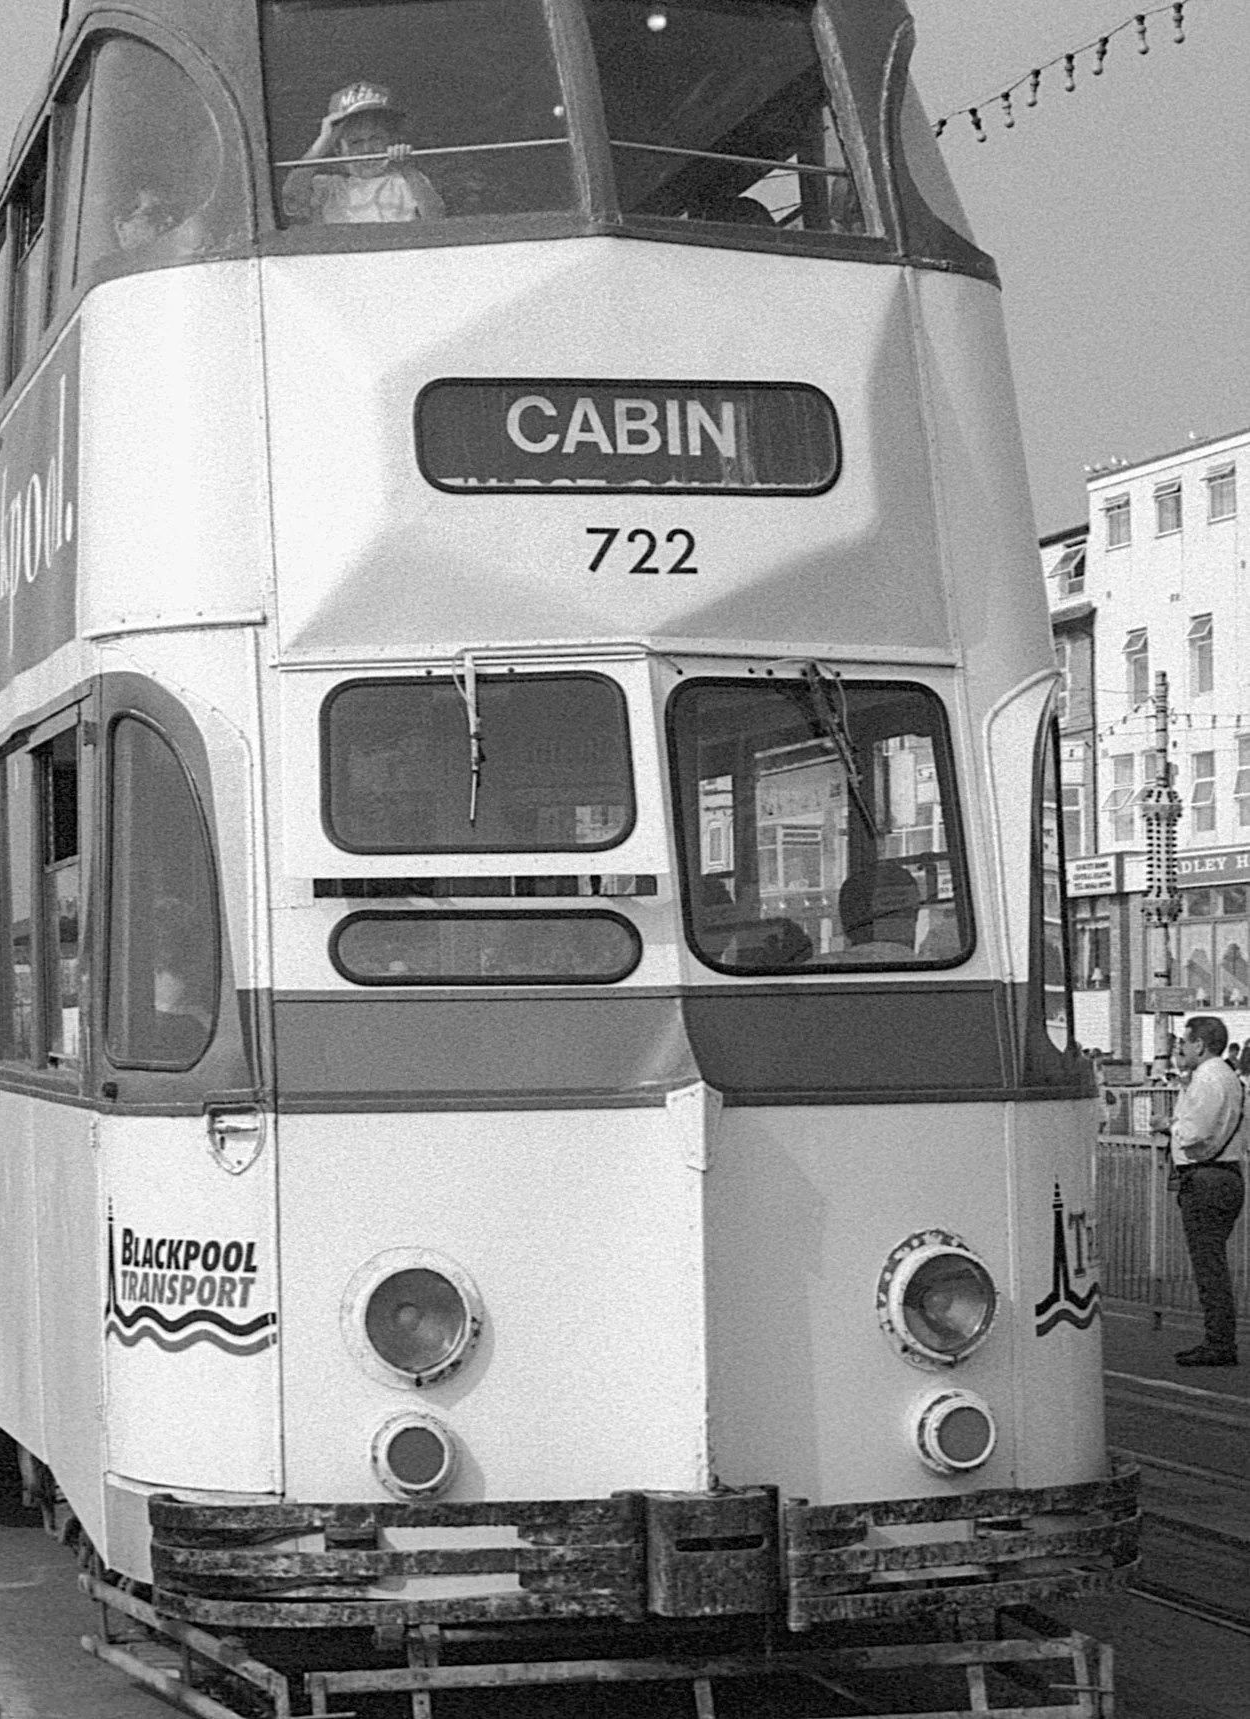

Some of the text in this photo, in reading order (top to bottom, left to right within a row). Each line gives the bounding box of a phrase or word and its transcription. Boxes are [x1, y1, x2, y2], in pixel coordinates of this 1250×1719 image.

[506, 395, 736, 458] CABIN
[586, 527, 698, 575] 722
[121, 1228, 257, 1273] BLACKPOOL
[121, 1270, 256, 1308] TRANSPORT
